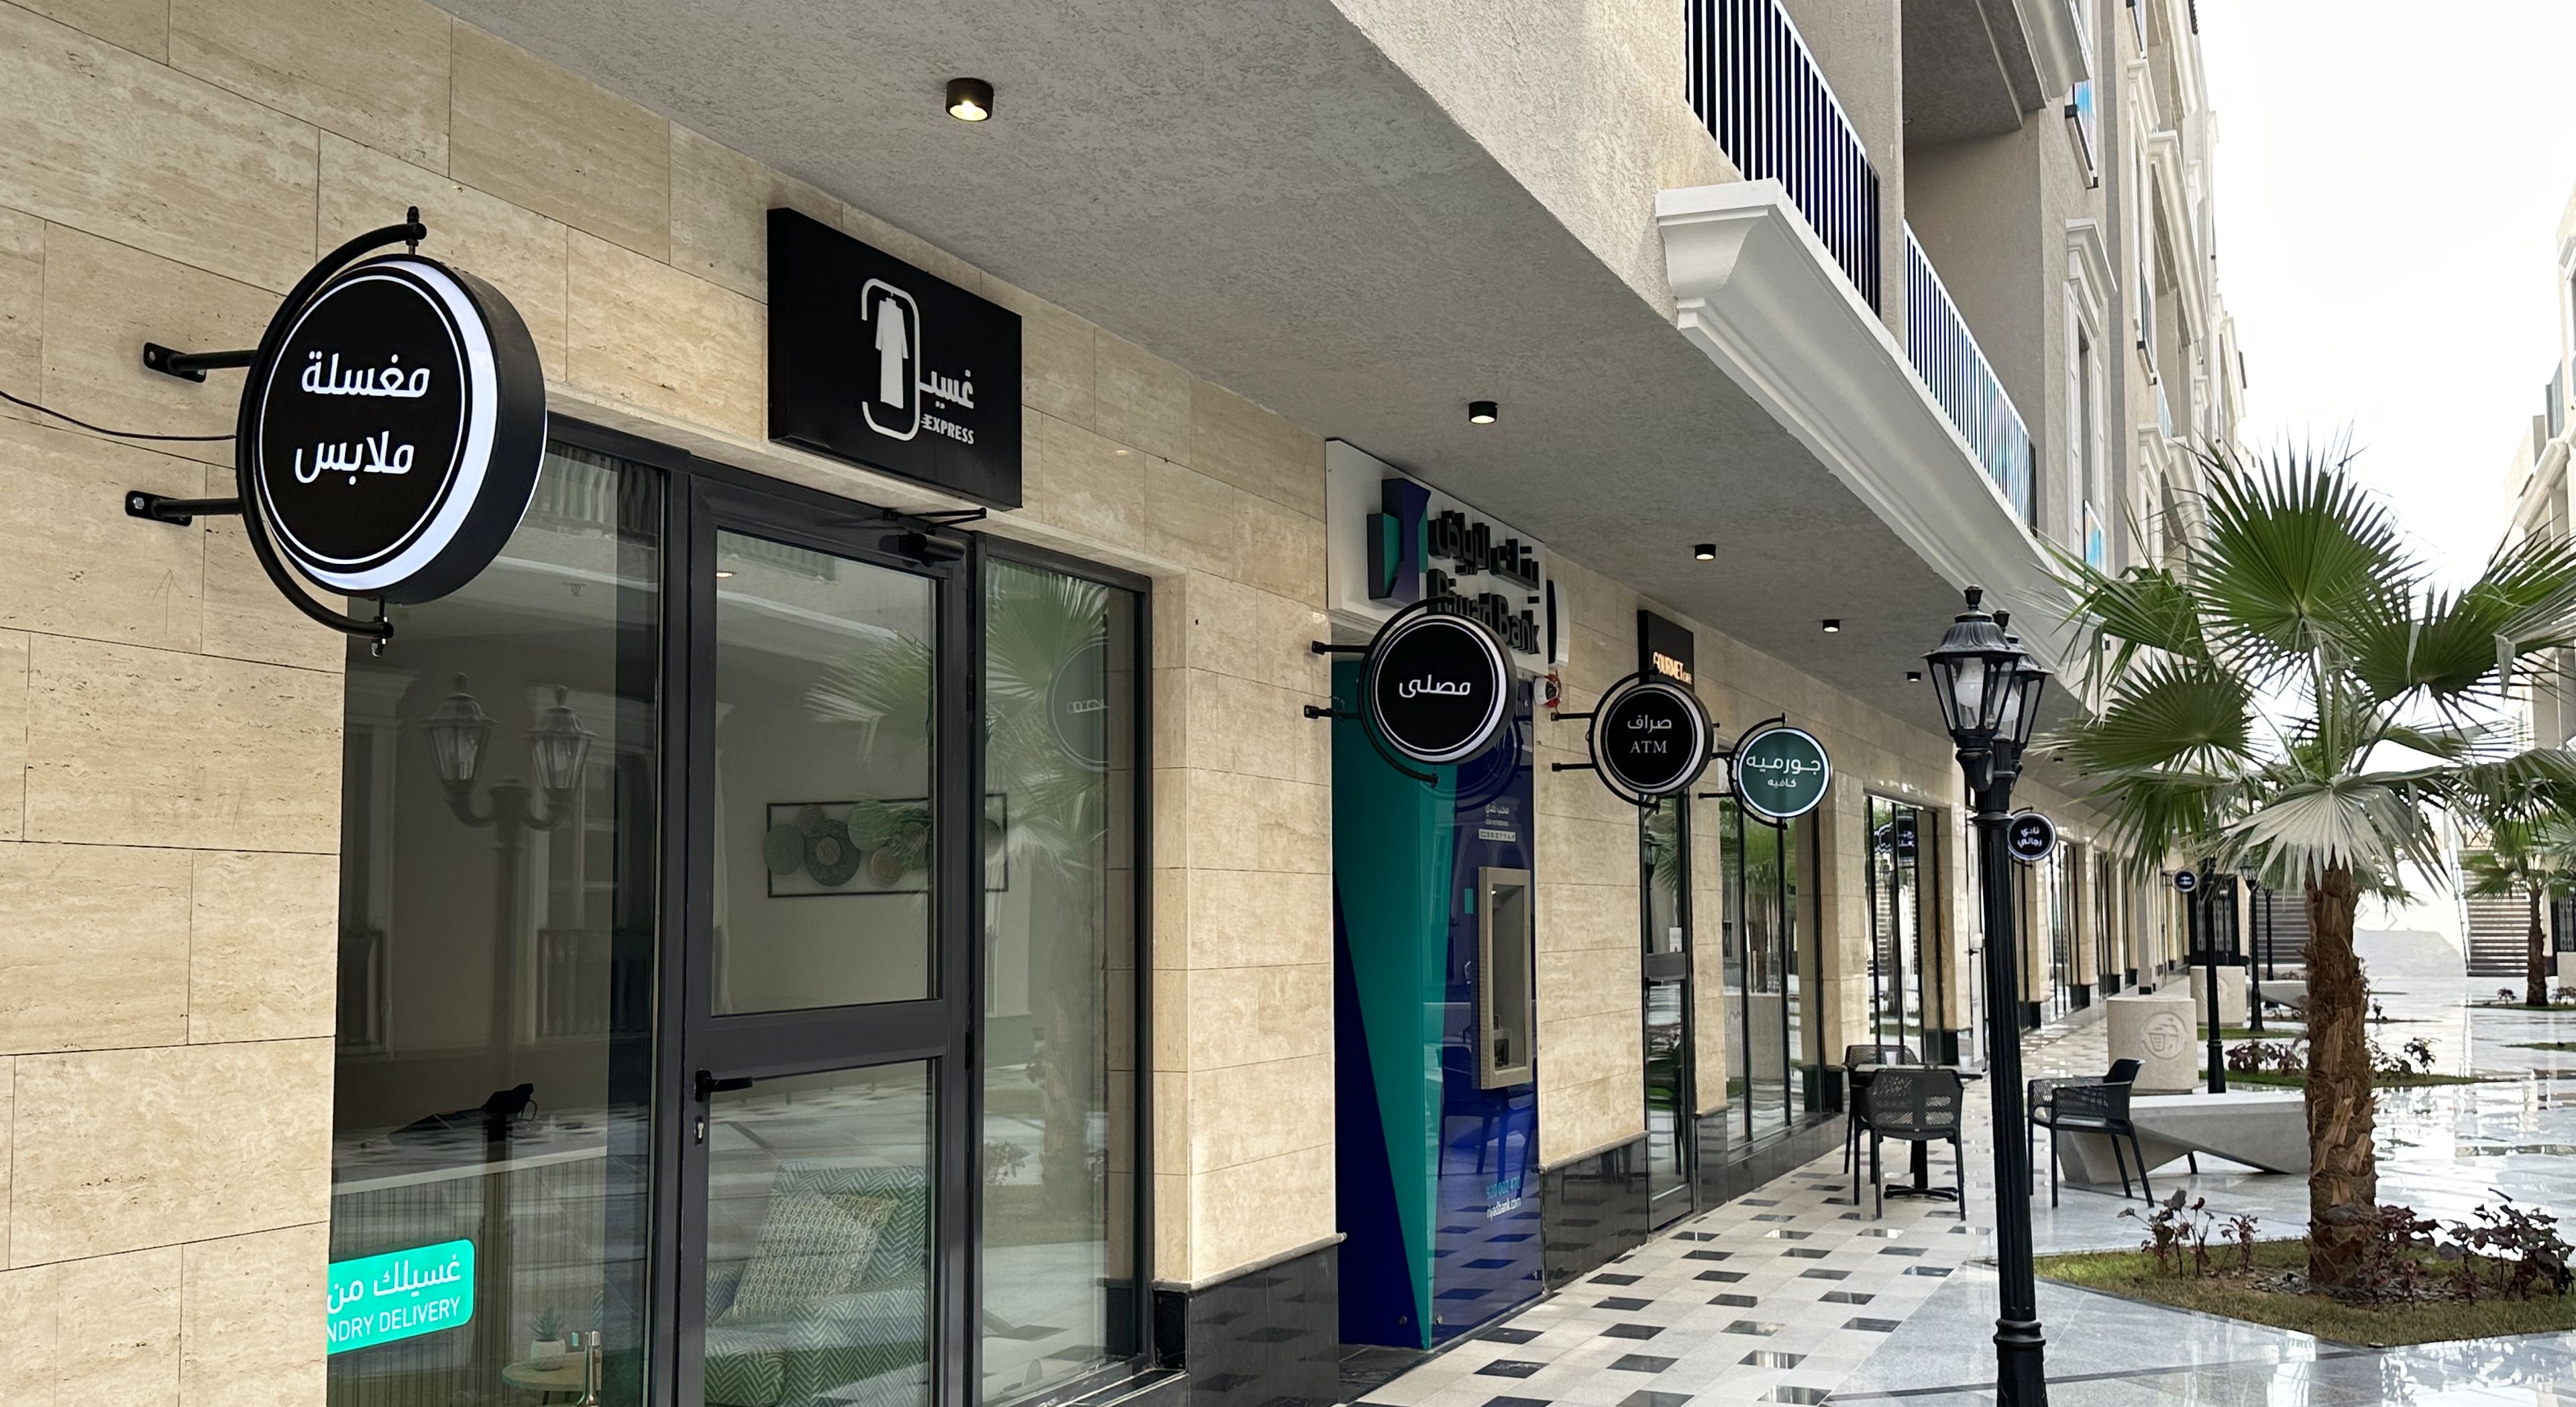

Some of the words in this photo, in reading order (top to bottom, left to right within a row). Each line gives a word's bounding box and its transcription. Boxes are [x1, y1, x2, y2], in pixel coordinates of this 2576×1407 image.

[301, 350, 431, 398] مغسلة
[921, 414, 975, 445] EXPRESS
[294, 431, 415, 486] ملابس
[1491, 594, 1541, 655] Bank
[1399, 674, 1471, 699] مصلى
[1627, 714, 1672, 734] صراف
[1629, 740, 1668, 754] ATM
[1746, 754, 1821, 775] جورميه
[1767, 778, 1797, 789] كافيه
[2021, 826, 2040, 837] نادي
[372, 1253, 462, 1298] غسيلك
[327, 1280, 364, 1314] من
[379, 1296, 461, 1333] DELIVERY
